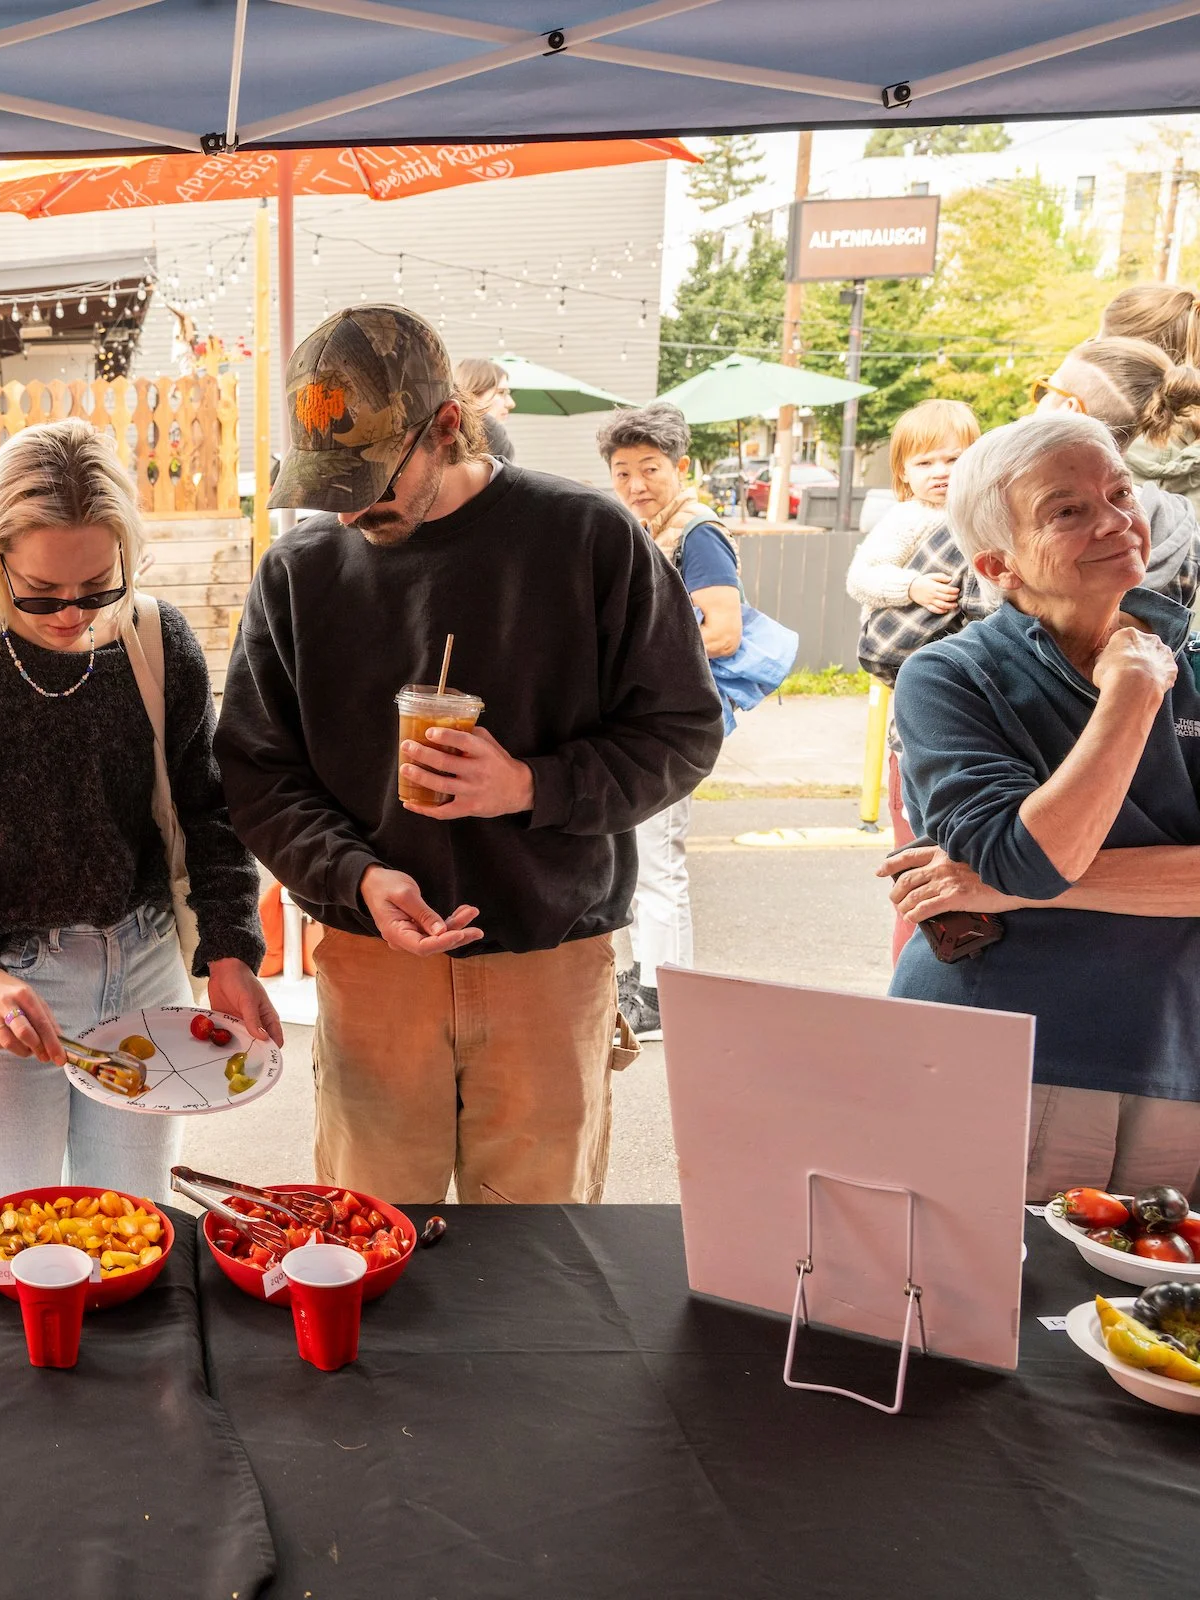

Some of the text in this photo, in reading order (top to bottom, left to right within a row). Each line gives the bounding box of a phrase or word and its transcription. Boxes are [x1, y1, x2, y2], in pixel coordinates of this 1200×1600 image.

[230, 154, 278, 189] 1919
[374, 155, 441, 198] peritif
[809, 227, 927, 249] ALPENRAUSCH
[1174, 722, 1194, 731] ORTH
[1178, 718, 1194, 726] THE
